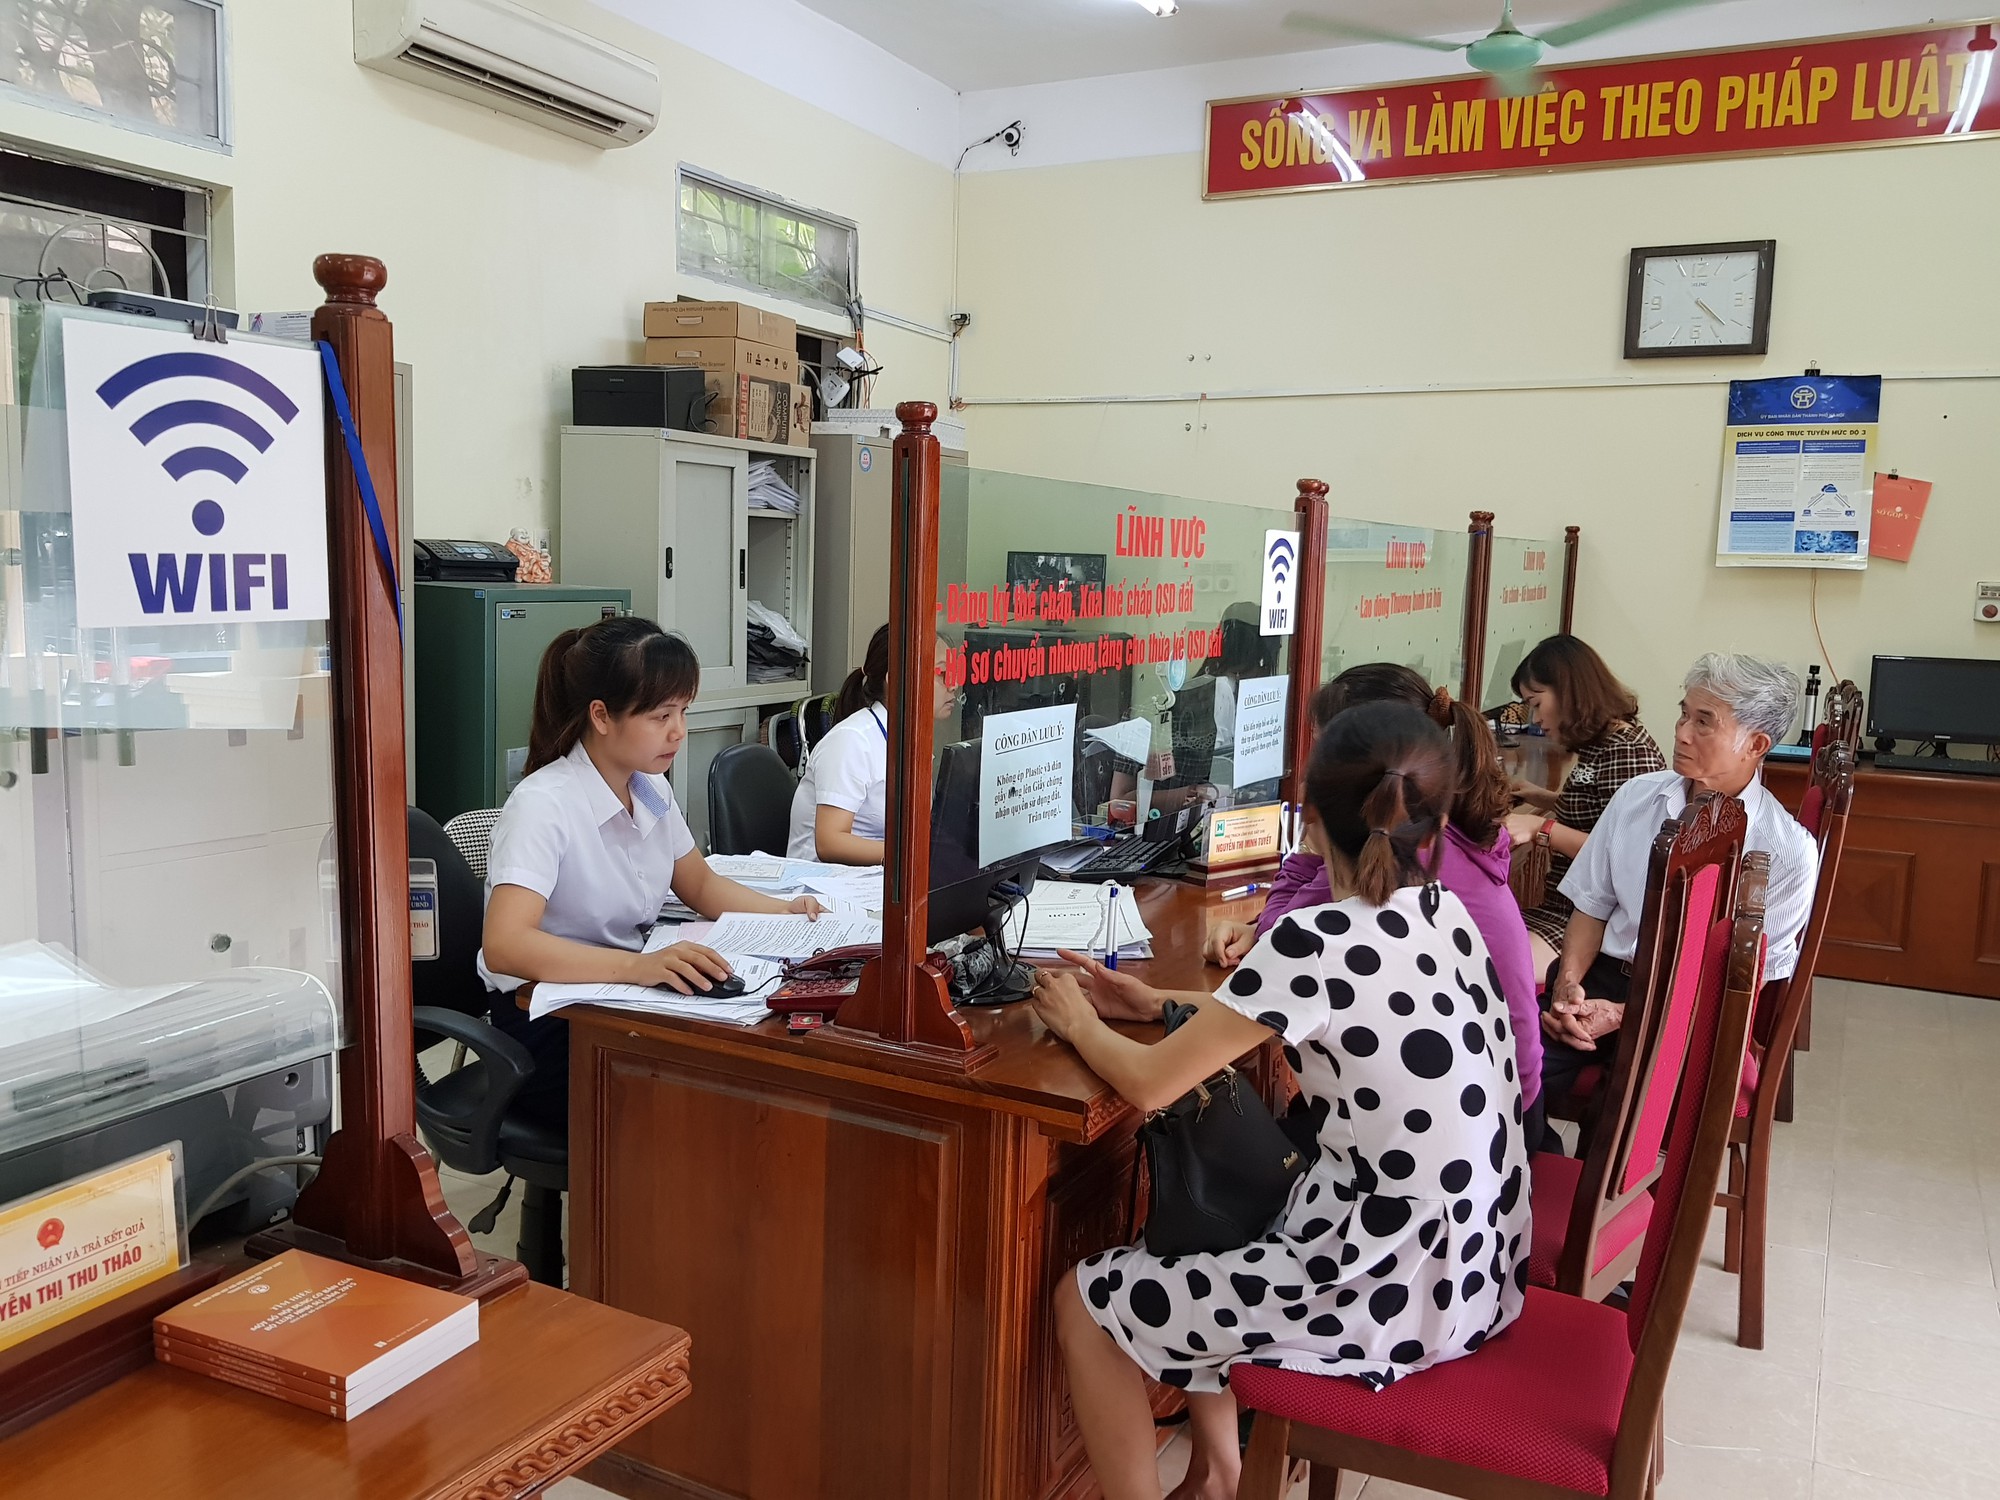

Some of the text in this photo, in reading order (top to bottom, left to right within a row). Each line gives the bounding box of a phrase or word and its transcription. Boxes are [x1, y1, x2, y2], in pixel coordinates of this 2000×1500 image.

[1239, 43, 1972, 171] SỐNG VÀ LÀM VIỆC THEO PHÁP LUẬT
[1116, 504, 1206, 568] LĨNH VỰC
[1386, 535, 1426, 574] LĨNH VỰC
[128, 553, 288, 614] WIFI
[947, 582, 988, 628] Đăng
[992, 582, 1011, 627] ký
[1014, 578, 1040, 622] thế
[1079, 583, 1104, 619] Xóa
[1105, 577, 1127, 618] thế
[1126, 577, 1152, 619] chấp
[1155, 583, 1176, 617] QSD
[1178, 575, 1195, 613] đất
[1269, 608, 1288, 629] WIFI
[944, 640, 968, 688] Hồ
[970, 648, 991, 685] sơ
[993, 631, 1046, 684] chuyển
[1125, 633, 1146, 666] cho
[1148, 631, 1170, 663] thừa
[1172, 626, 1187, 661] kế
[1187, 629, 1206, 662] QSD
[1207, 622, 1224, 658] đất
[995, 733, 1019, 751] CÔNG
[1021, 727, 1038, 745] DÂN
[1039, 724, 1056, 740] LƯU
[996, 773, 1017, 787] Không
[1017, 770, 1025, 783] ép
[1025, 764, 1043, 779] Plastic
[1033, 776, 1045, 791] Giấy
[4, 1217, 146, 1287] TIẾP NHẬN VÀ TRẢ KẾT QUẢ
[36, 1279, 63, 1300] THỊ
[67, 1263, 98, 1292] THU
[102, 1242, 142, 1276] THẢO
